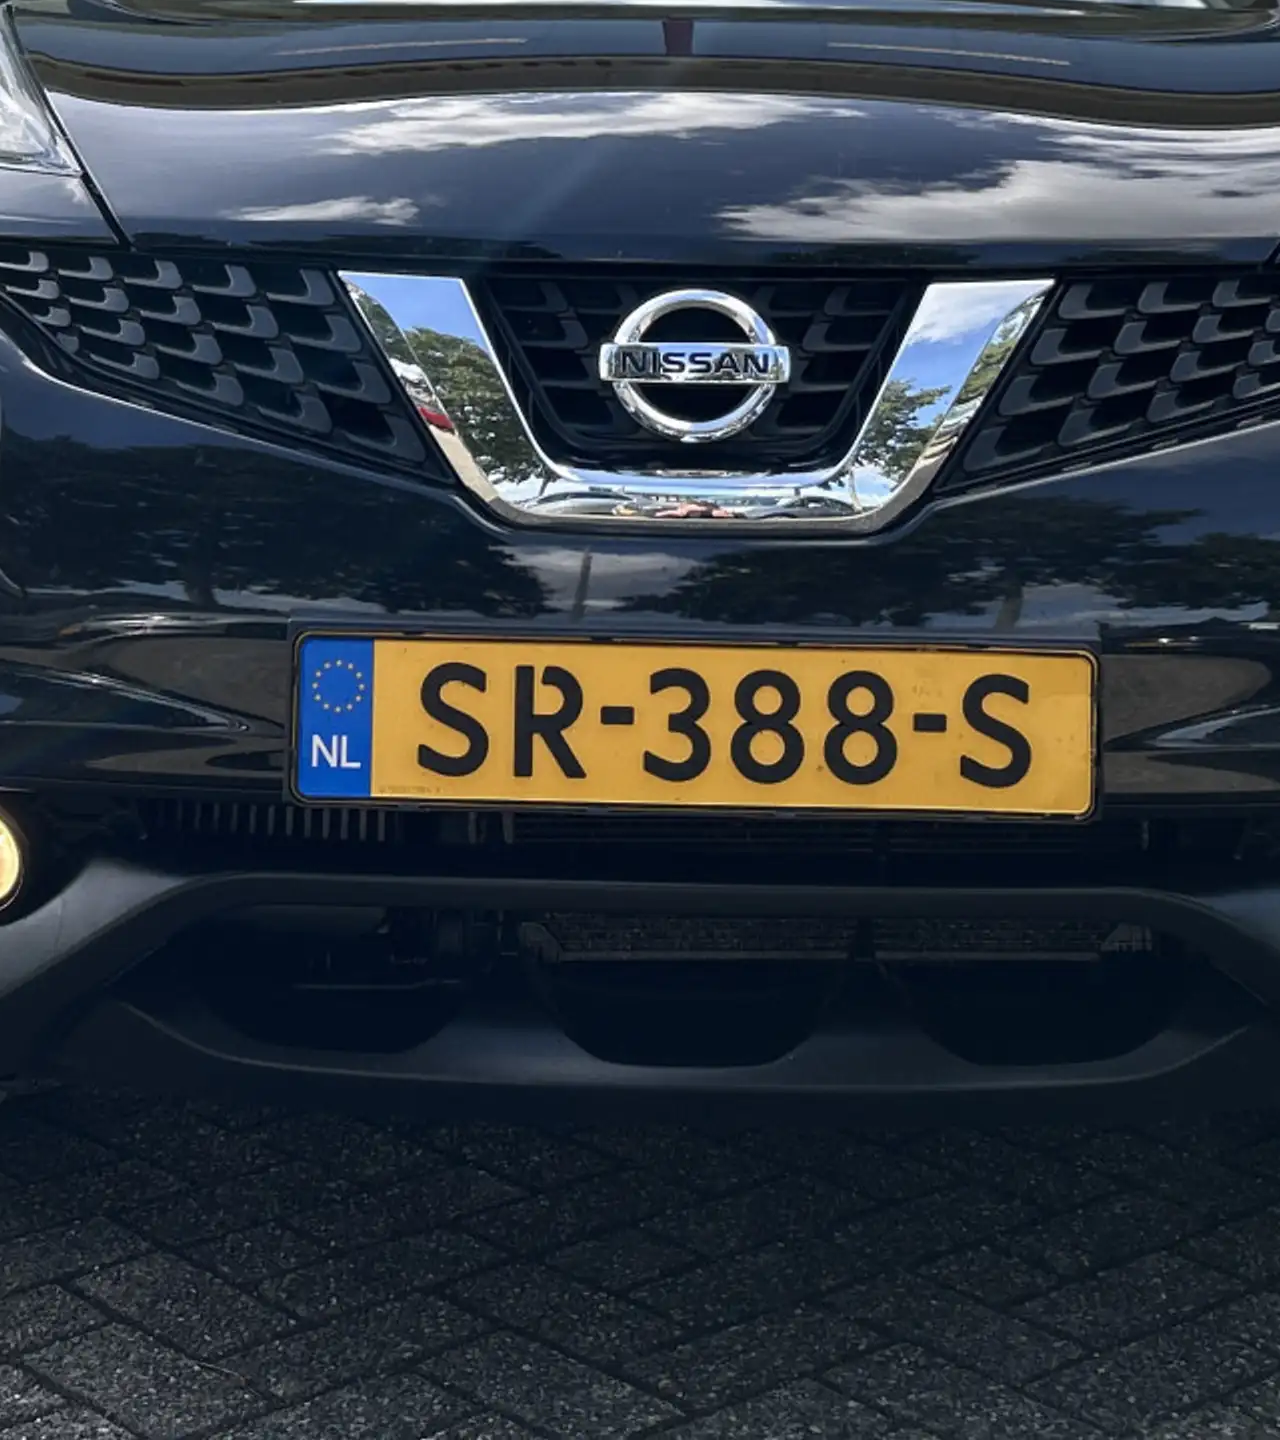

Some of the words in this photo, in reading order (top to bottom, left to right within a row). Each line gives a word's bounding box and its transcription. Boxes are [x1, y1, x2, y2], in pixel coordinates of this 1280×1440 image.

[621, 351, 770, 374] NISSAN
[416, 661, 1033, 789] SR-388-S
[311, 734, 361, 769] NL
